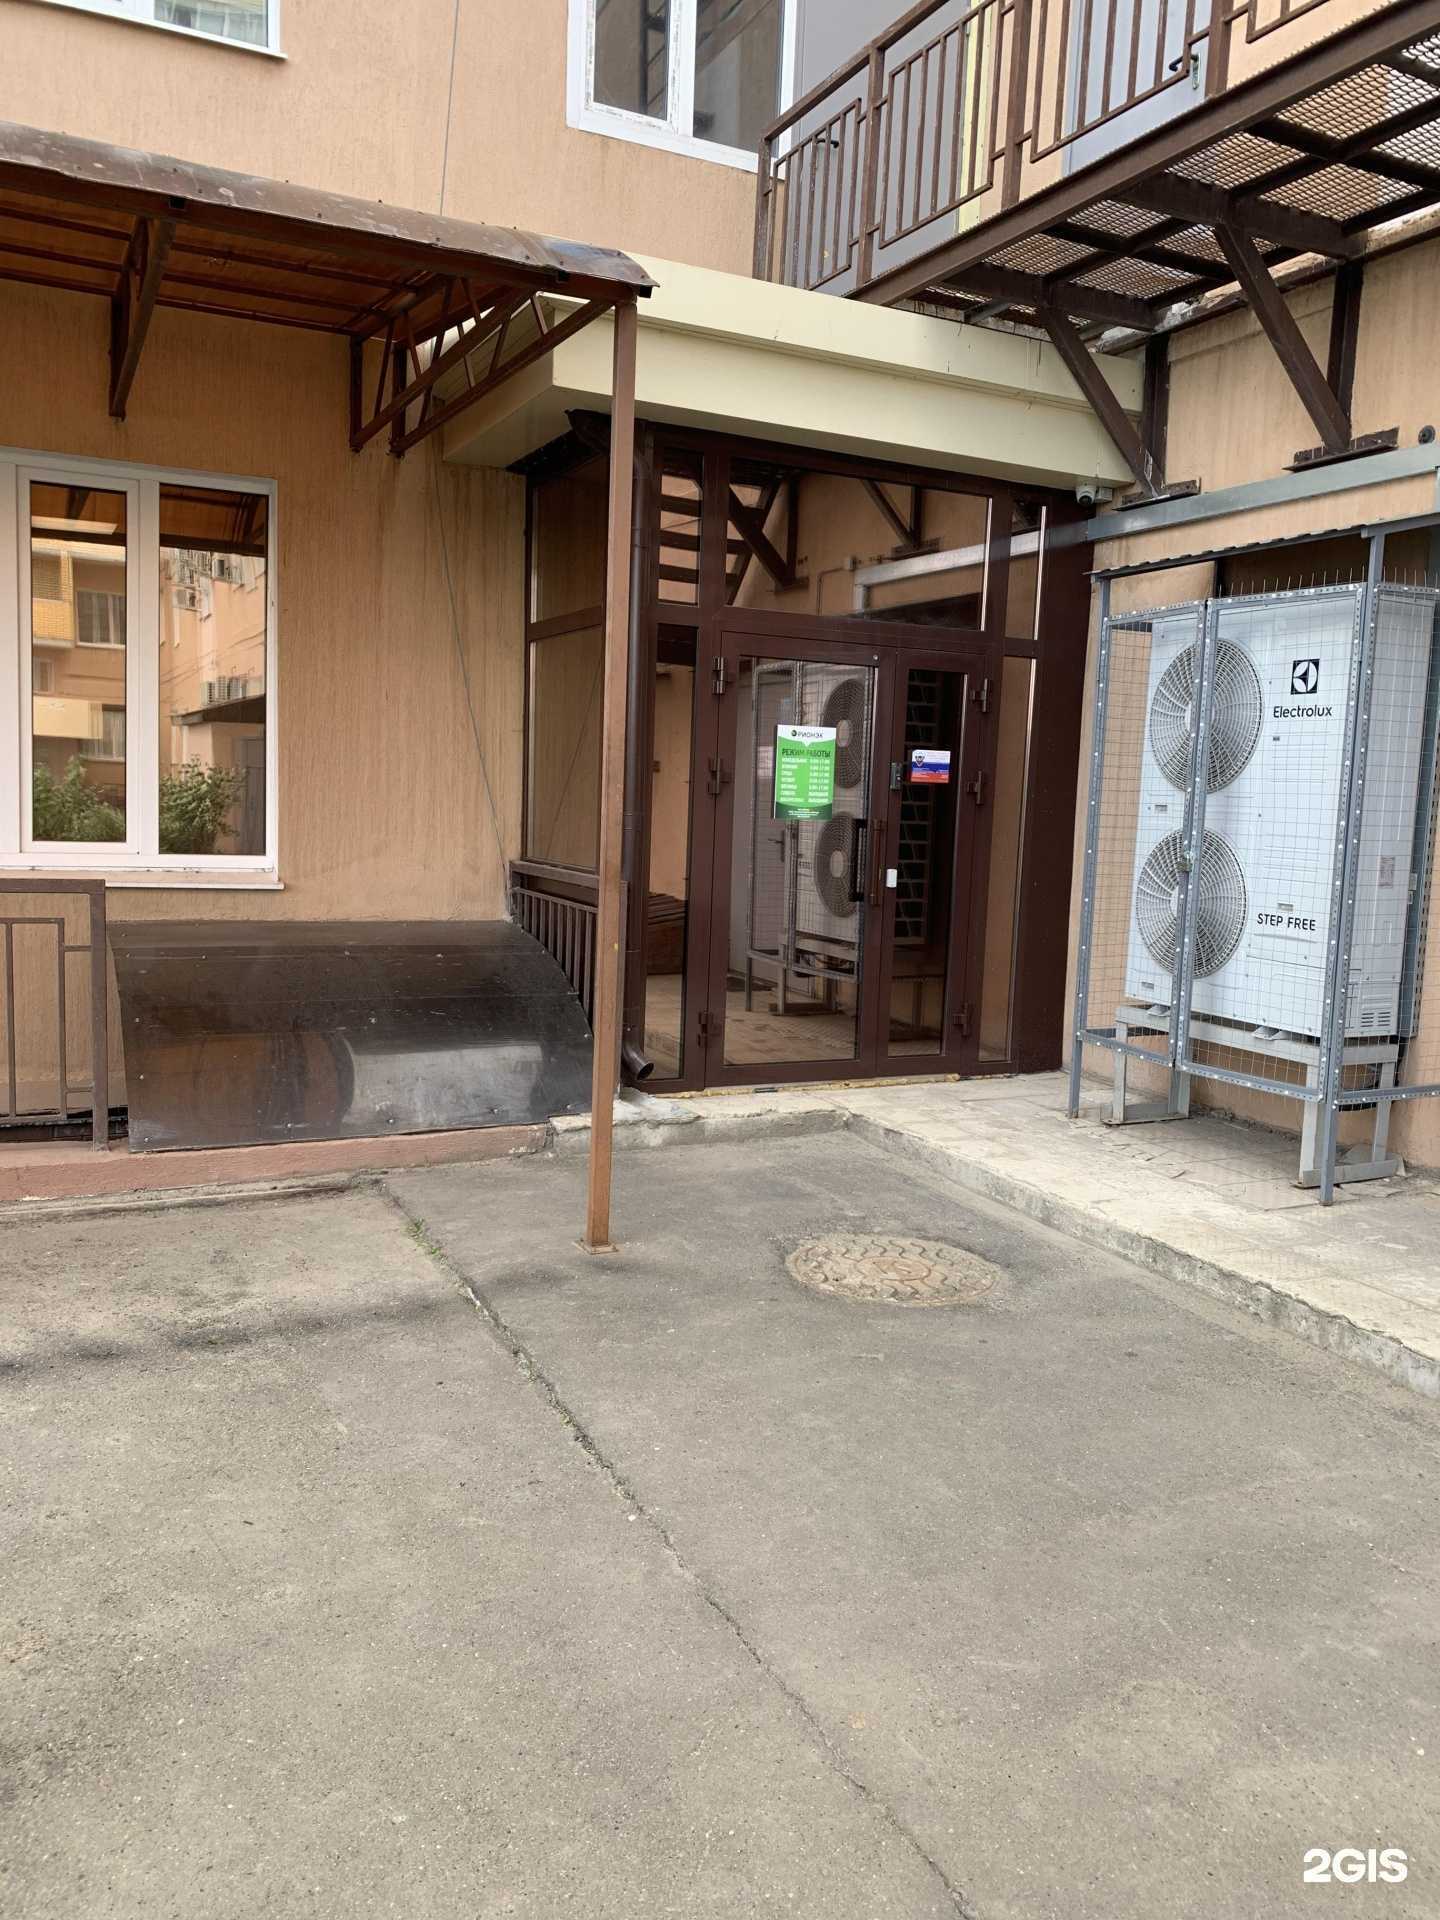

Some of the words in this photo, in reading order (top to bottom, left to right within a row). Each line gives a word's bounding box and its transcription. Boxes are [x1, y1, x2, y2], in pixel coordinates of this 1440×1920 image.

[1273, 705, 1332, 718] Electrolux
[782, 748, 804, 756] РЕЖИМ
[807, 749, 831, 758] РАБОТЫ
[1257, 913, 1283, 926] STEP
[1287, 917, 1316, 931] FREE
